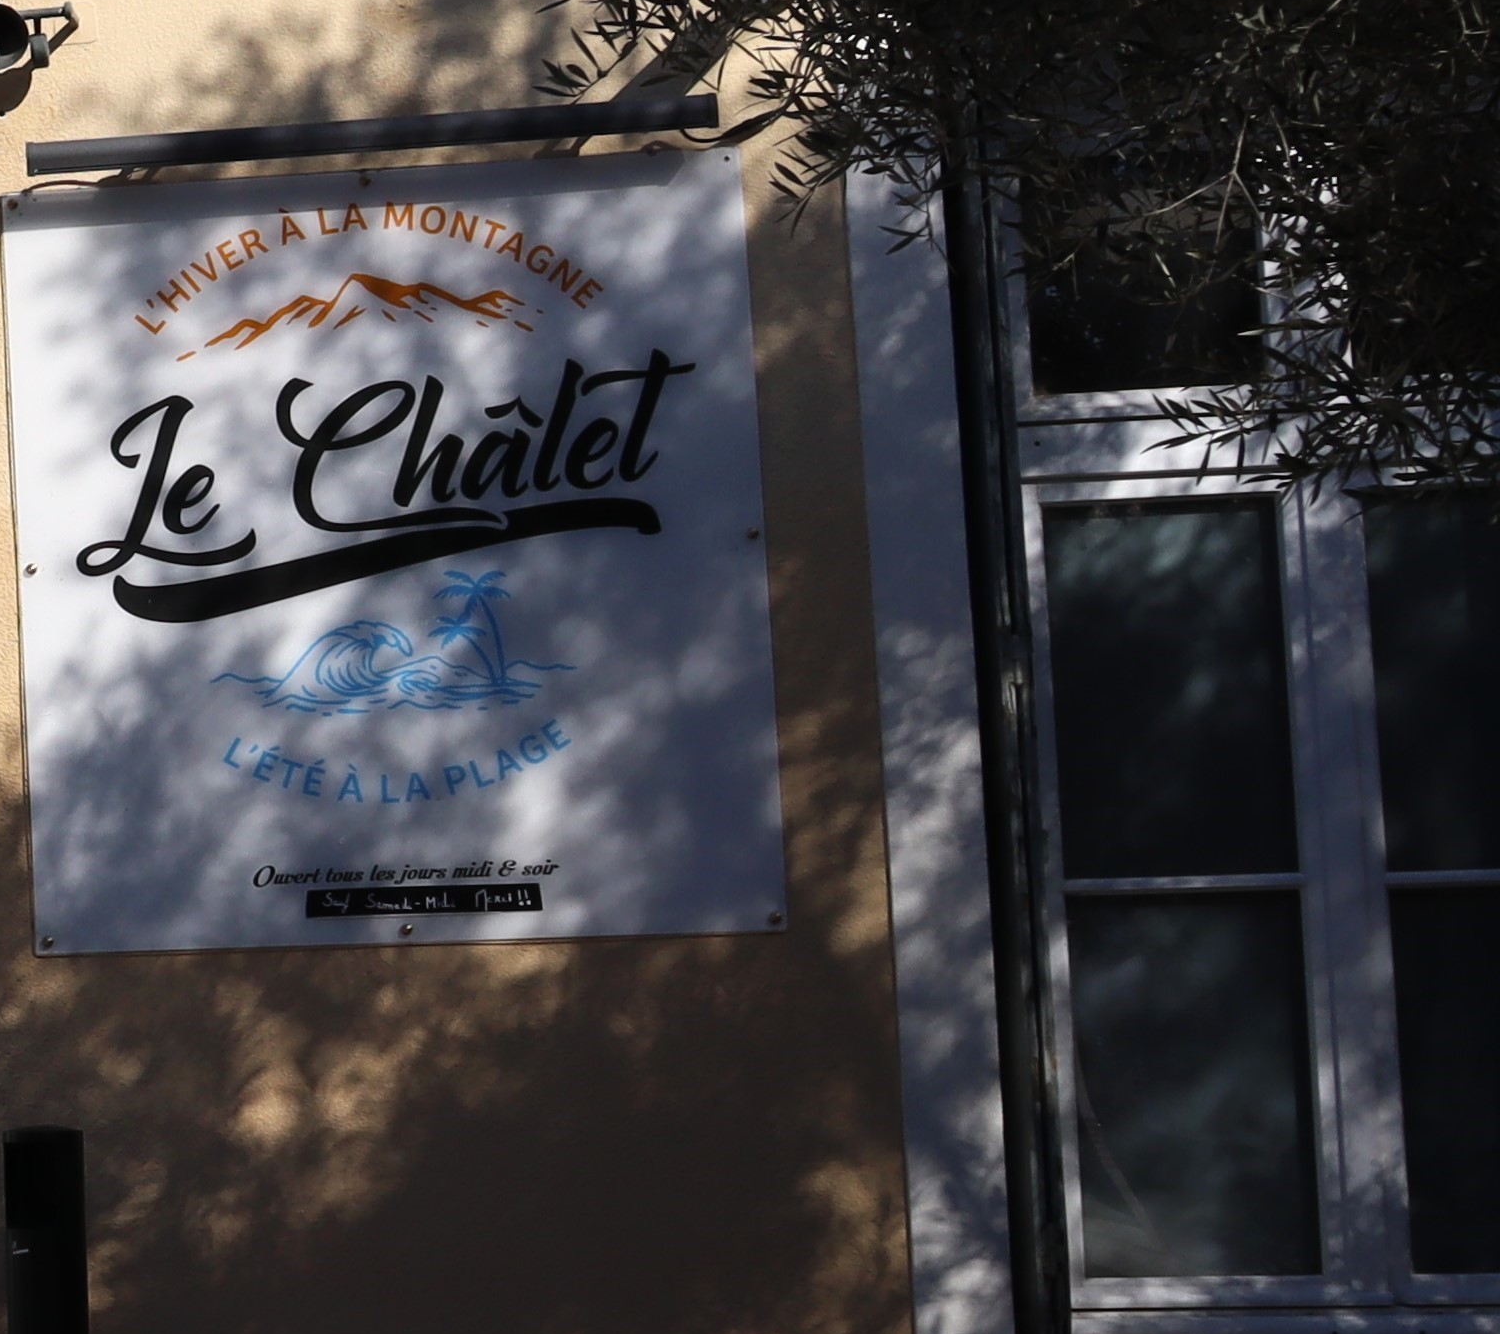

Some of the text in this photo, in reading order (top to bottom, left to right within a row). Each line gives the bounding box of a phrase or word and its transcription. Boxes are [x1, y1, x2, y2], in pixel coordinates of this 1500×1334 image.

[134, 200, 605, 336] L'HIVER À LA MONTAGNE
[75, 347, 698, 578] Le Châlet
[222, 719, 573, 805] L'ÉTÉ À LA PLAGE
[252, 858, 560, 889] Ouvert tous les jours midi & soir
